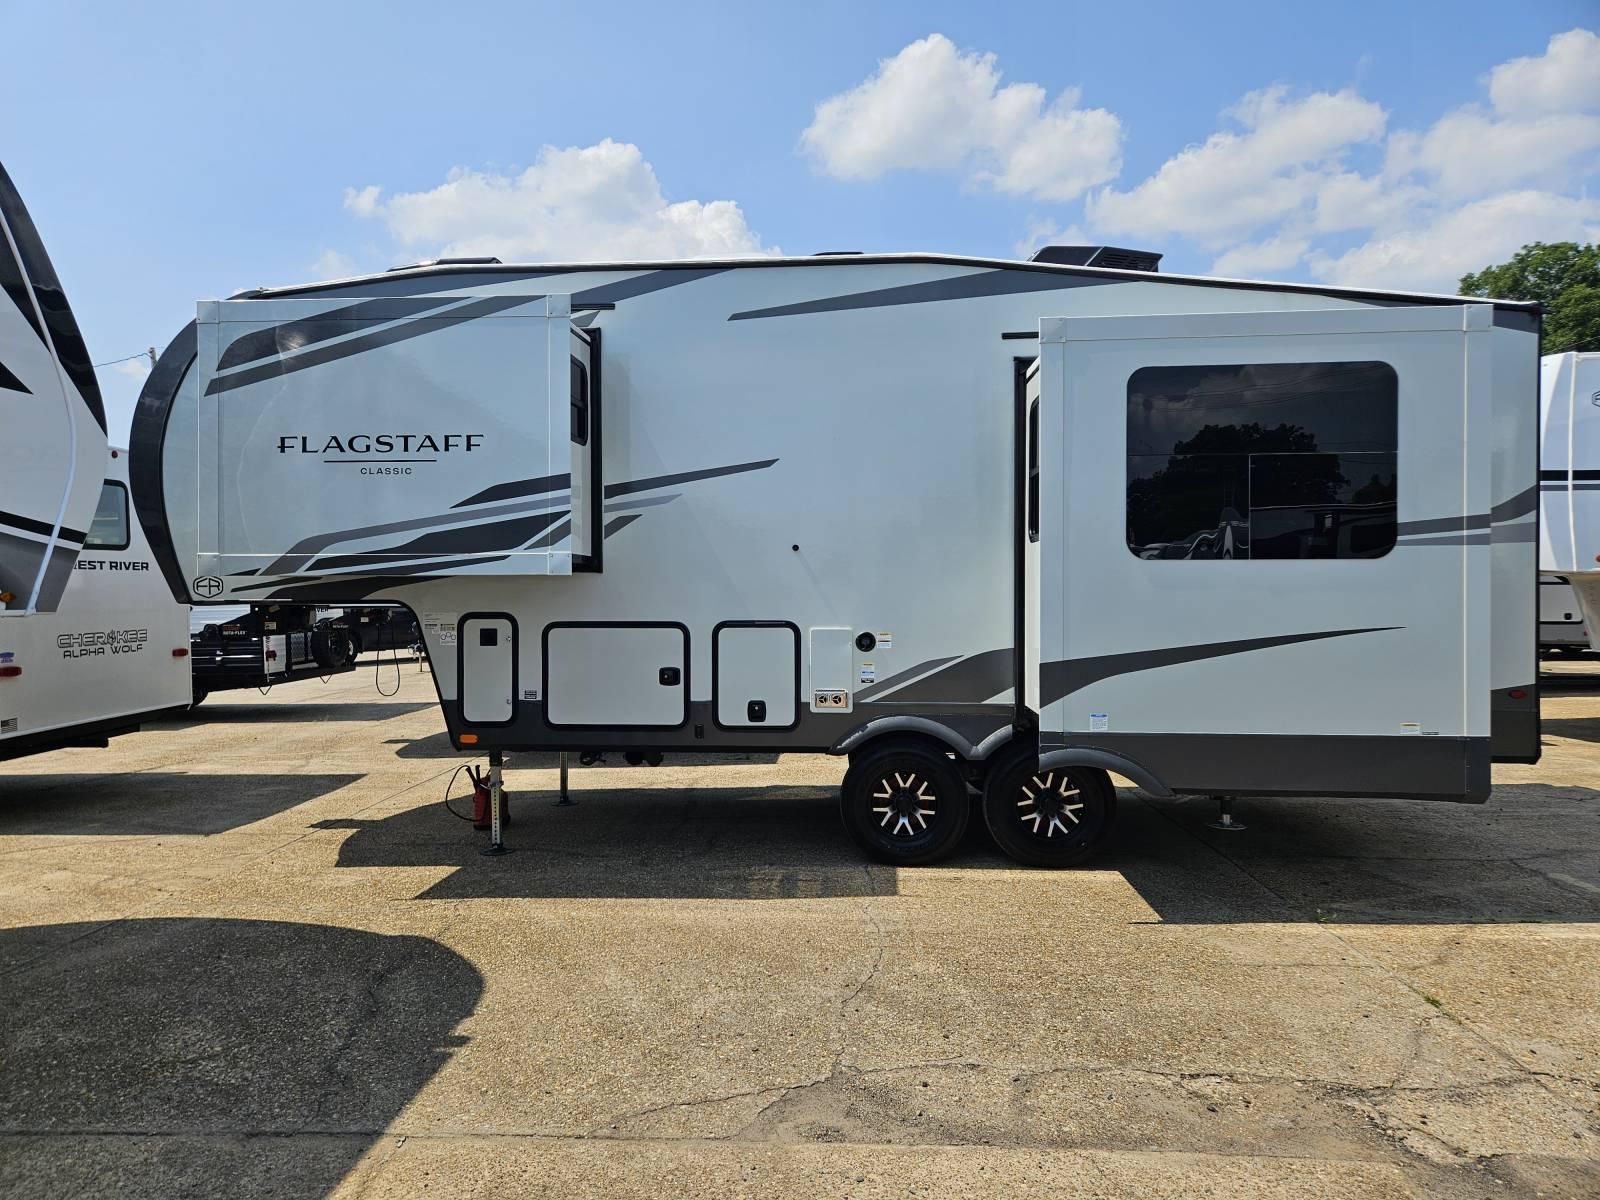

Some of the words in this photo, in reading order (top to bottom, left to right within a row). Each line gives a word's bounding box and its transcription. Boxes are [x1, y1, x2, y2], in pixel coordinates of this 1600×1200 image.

[277, 434, 484, 454] FLAGSTAFF
[360, 467, 412, 475] CLASSIC
[109, 561, 149, 571] RIVER
[57, 629, 147, 648] CHEROKEE
[63, 647, 105, 659] ALPHA
[110, 643, 143, 655] WOLF
